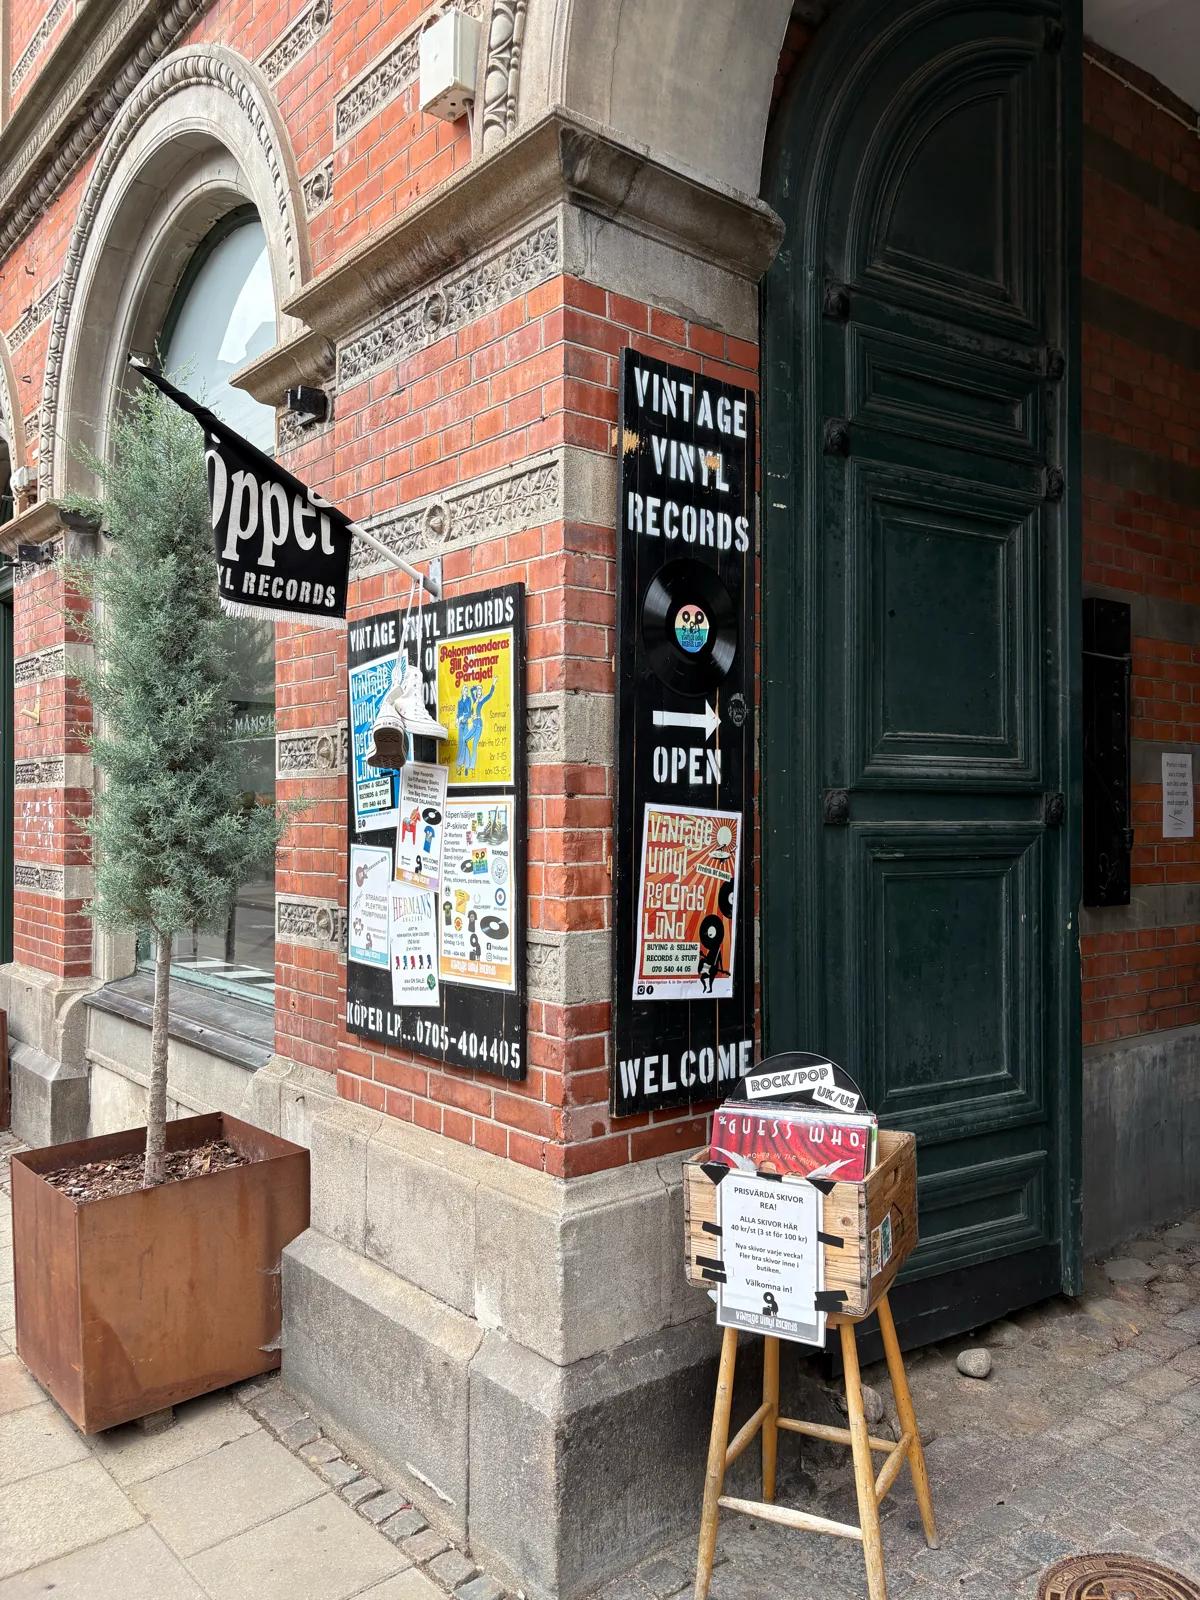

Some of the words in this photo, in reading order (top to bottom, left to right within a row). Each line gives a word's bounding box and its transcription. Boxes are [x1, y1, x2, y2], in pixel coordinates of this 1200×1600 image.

[634, 366, 748, 439] VINTAGE
[651, 435, 729, 492] VINYL
[627, 491, 750, 553] RECORDS
[242, 571, 336, 608] RECORDS
[350, 621, 396, 652] VINTAGE
[448, 595, 514, 634] RECORDS
[653, 746, 722, 785] OPEN
[346, 1000, 384, 1032] KÖPER
[619, 1039, 753, 1099] WELCOME
[751, 1067, 829, 1092] ROCK/POP
[816, 1085, 856, 1109] UK/US
[728, 1118, 793, 1140] GUESS
[734, 1187, 775, 1200] PRISVÄRDA
[776, 1194, 804, 1204] SKIVOR
[760, 1202, 777, 1210] REA!
[740, 1216, 756, 1224] ALLA
[757, 1218, 782, 1228] SKIVOR
[783, 1222, 798, 1230] HÄR
[741, 1225, 756, 1234] kr/st
[785, 1233, 796, 1241] 100
[798, 1235, 807, 1244] kr)
[736, 1242, 747, 1250] Nya
[748, 1245, 765, 1253] skivor
[783, 1252, 803, 1260] vecka!
[763, 1257, 781, 1265] skivor
[757, 1264, 781, 1274] butiken.
[745, 1278, 781, 1291] Välkomna
[783, 1285, 792, 1293] in!
